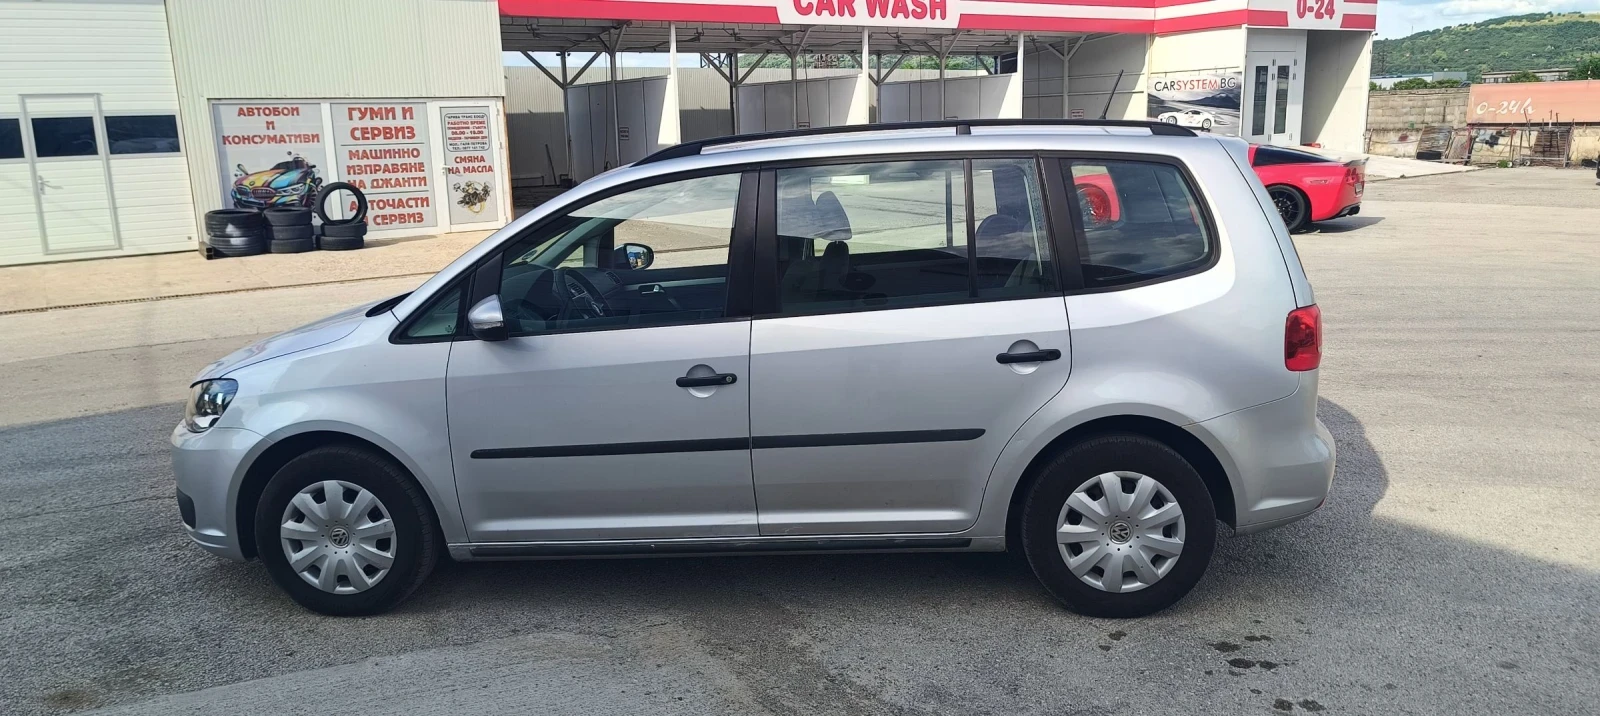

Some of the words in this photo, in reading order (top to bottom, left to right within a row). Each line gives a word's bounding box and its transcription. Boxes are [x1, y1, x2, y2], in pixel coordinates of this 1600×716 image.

[793, 0, 856, 17] CAR
[866, 0, 946, 20] WASH
[1297, 0, 1335, 20] 0-24
[237, 106, 300, 117] АВТОБОИ
[348, 107, 396, 121] ГУМИ
[402, 106, 414, 120] И
[266, 120, 275, 130] И
[222, 133, 320, 145] КОНСУМАТИВИ
[350, 125, 416, 141] СЕРВИЗ
[348, 148, 420, 160] МАШИННО
[454, 155, 485, 164] СМЯНА
[346, 162, 425, 175] ИЗПРАВЯНЕ
[448, 166, 460, 174] НА
[463, 164, 493, 174] МАСЛА
[370, 176, 427, 189] ДЖАНТИ
[349, 197, 430, 212] АТОЧАСТИ
[373, 212, 424, 226] СЕРВИЗ
